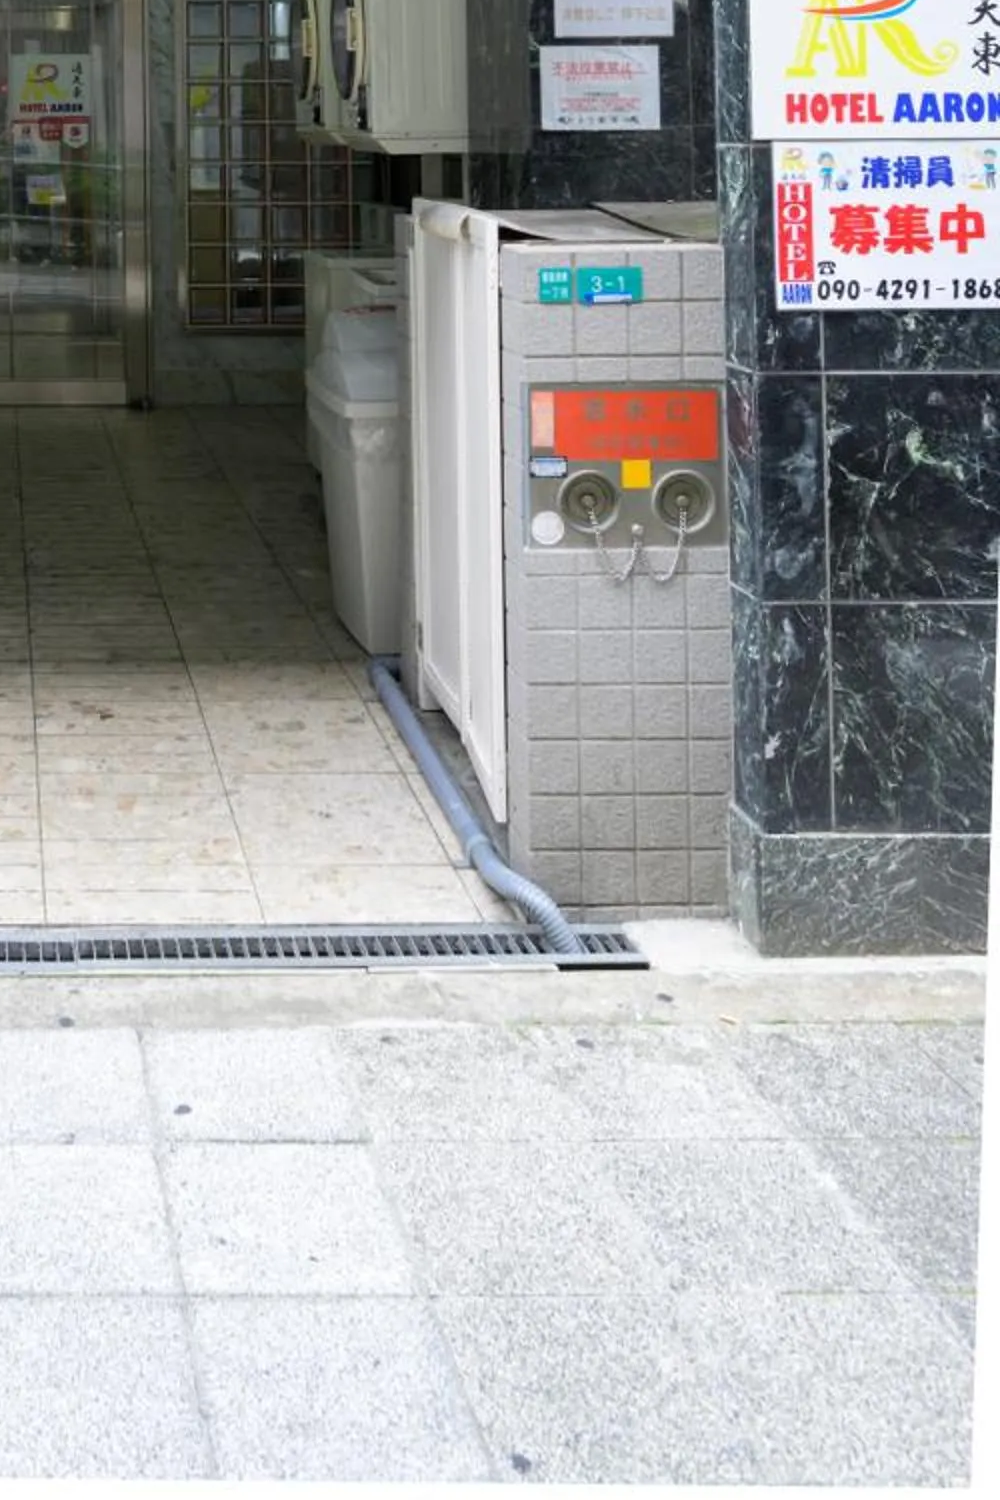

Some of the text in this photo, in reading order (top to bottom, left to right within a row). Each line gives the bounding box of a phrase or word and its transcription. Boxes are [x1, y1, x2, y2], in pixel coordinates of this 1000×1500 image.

[785, 92, 884, 124] HOTEL
[860, 155, 955, 189] 清掃員
[782, 183, 808, 281] HOTEL
[829, 202, 986, 255] 募集中
